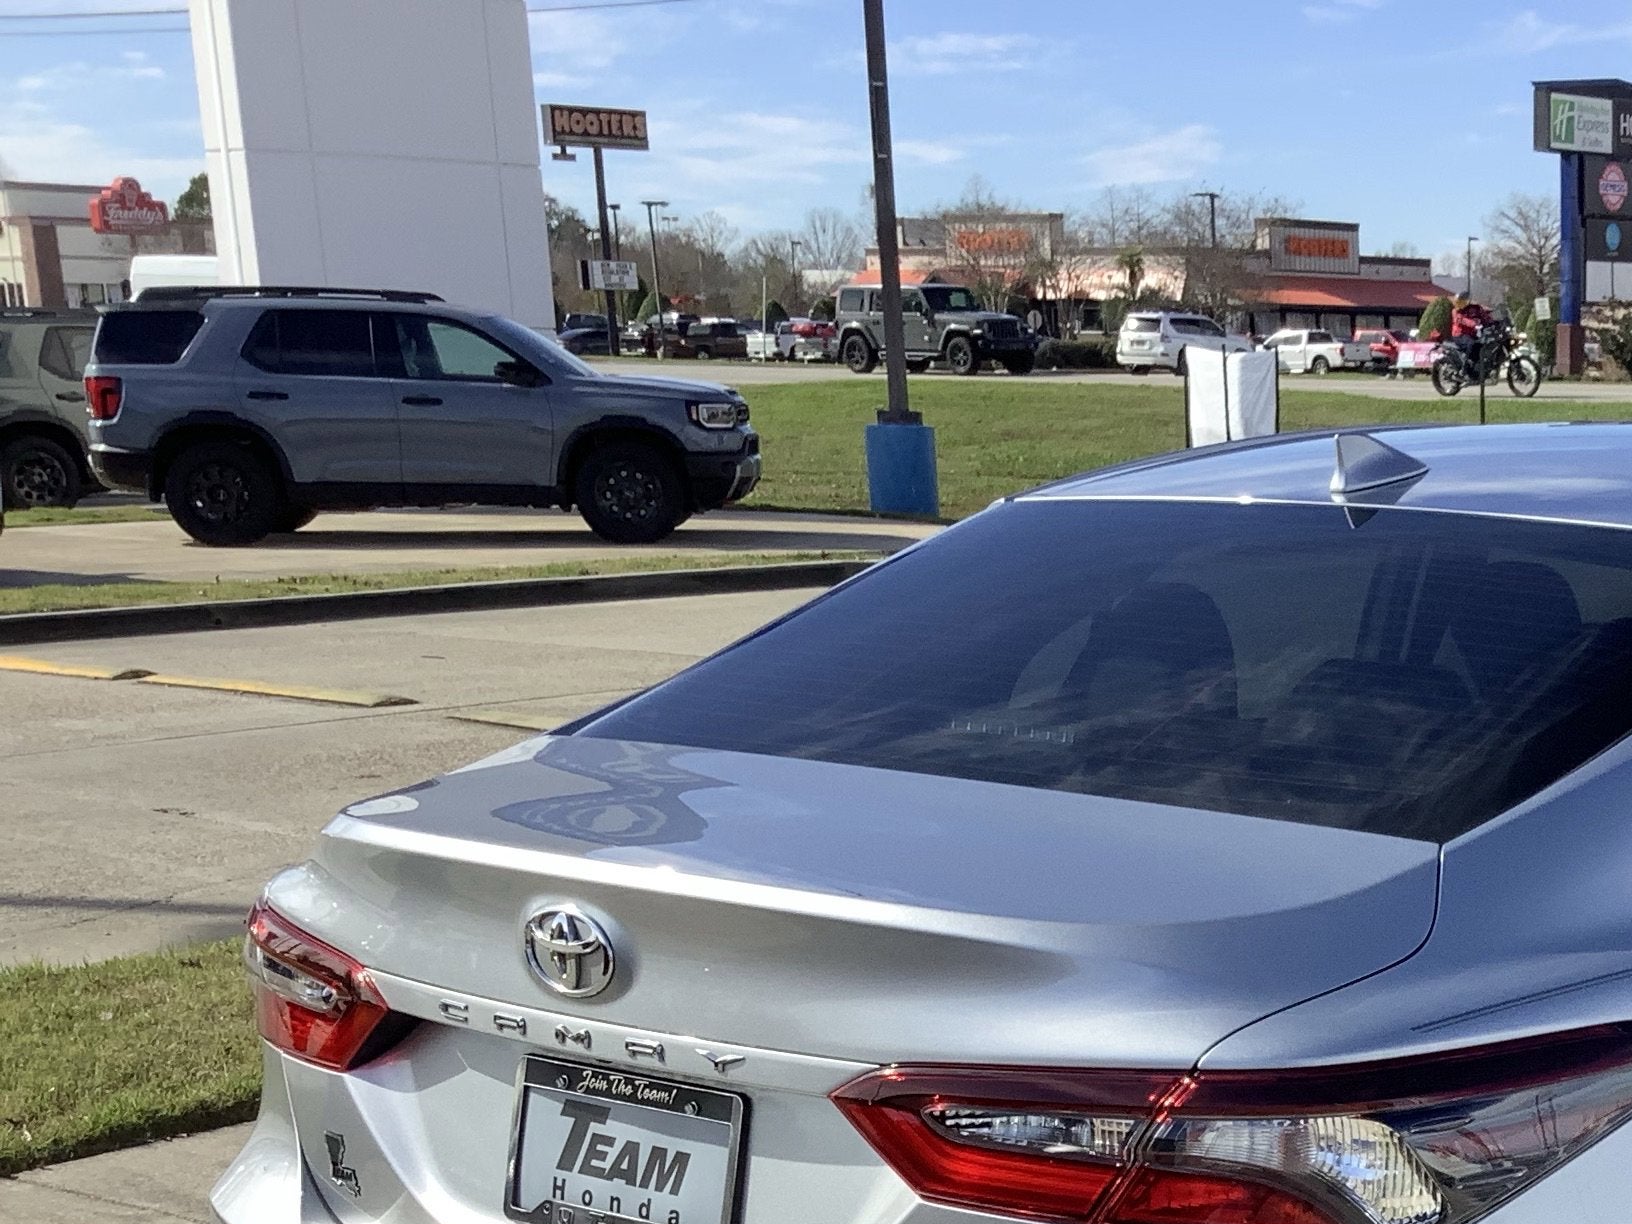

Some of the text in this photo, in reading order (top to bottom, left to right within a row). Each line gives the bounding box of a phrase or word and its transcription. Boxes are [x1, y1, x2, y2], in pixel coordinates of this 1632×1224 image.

[553, 109, 646, 138] HOOTERS
[438, 998, 746, 1074] CAMRY
[576, 1069, 678, 1105] Join The Team!
[555, 1098, 692, 1197] TEAM
